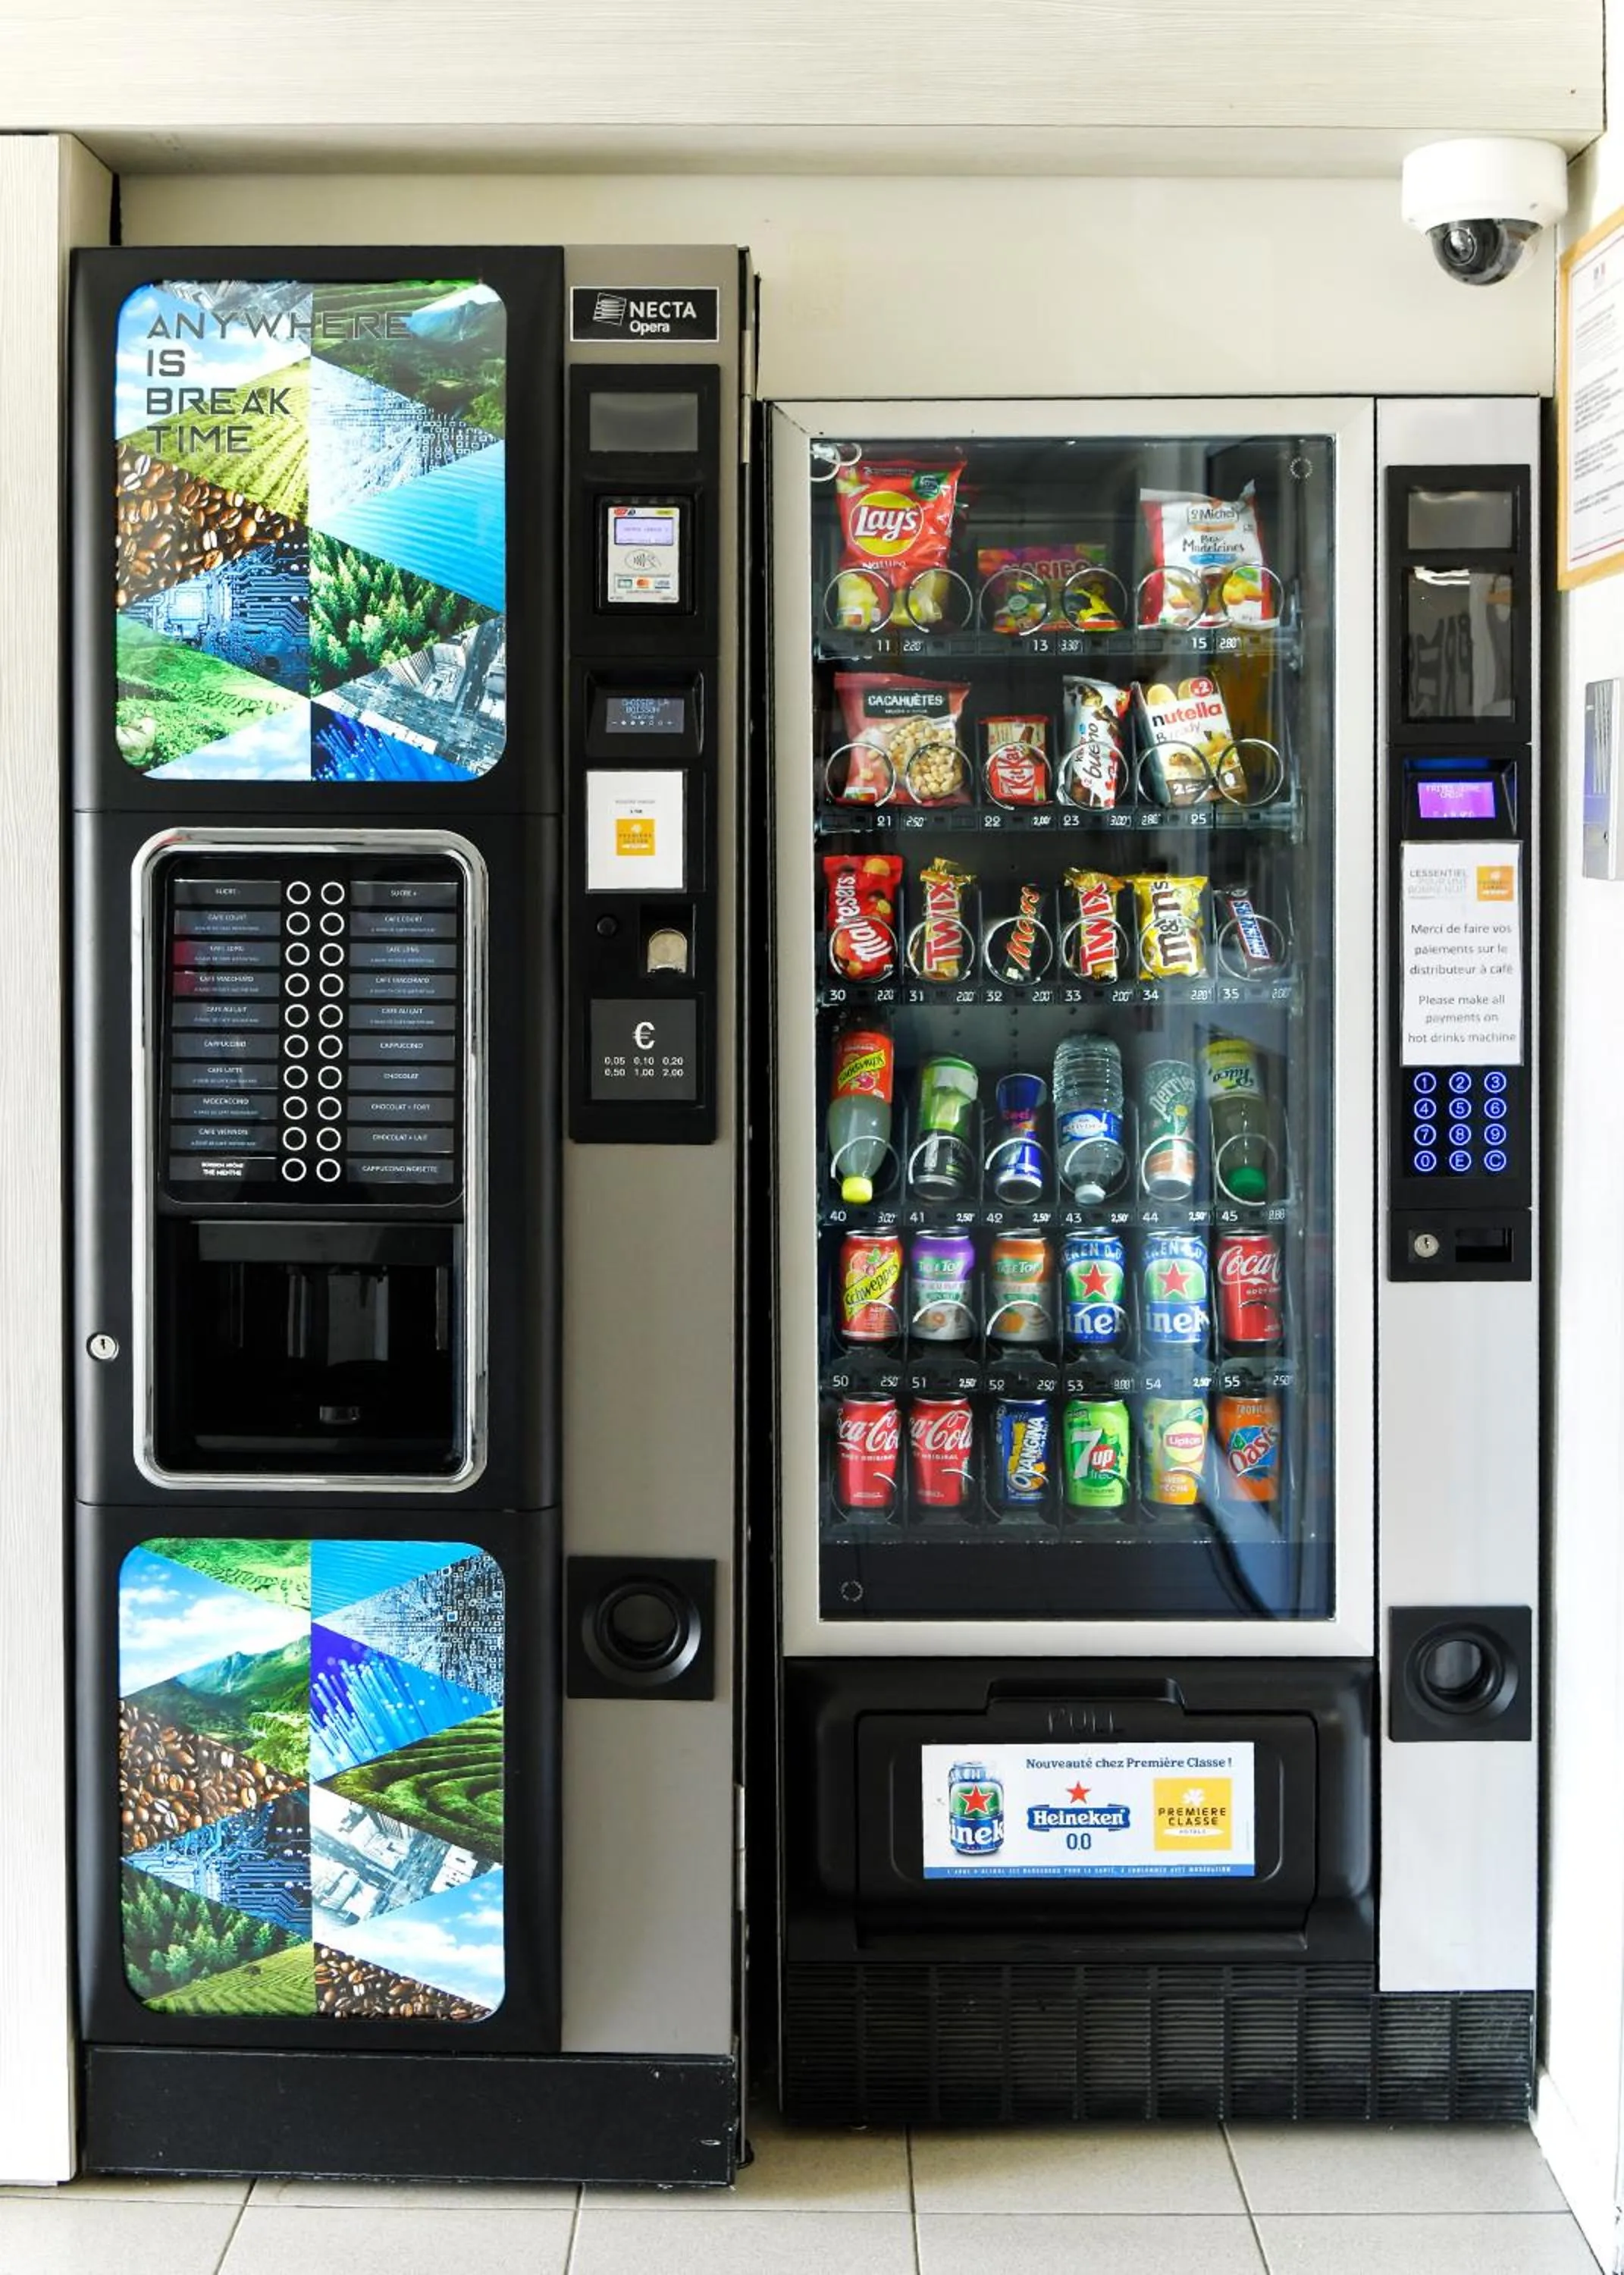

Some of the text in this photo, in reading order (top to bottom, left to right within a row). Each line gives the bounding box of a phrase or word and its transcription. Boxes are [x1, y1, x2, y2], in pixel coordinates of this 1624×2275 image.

[629, 301, 697, 318] NECTA
[146, 310, 414, 340] ANYWHERE
[629, 320, 670, 335] Opera
[146, 350, 186, 378] IS
[146, 388, 291, 416] BREAK
[147, 425, 254, 454] TIME
[854, 507, 919, 541] Lay's
[876, 640, 890, 652] 11
[1033, 639, 1049, 651] 13
[1193, 637, 1208, 649] 15
[867, 693, 944, 707] CACAHUÈTES
[1152, 701, 1224, 727] nutella
[1083, 723, 1102, 780] bueno
[923, 882, 963, 971] TWIX
[1080, 882, 1118, 976] TWIX
[1411, 923, 1513, 934] Merci de faire vos
[1414, 945, 1475, 956] paiements
[1497, 943, 1508, 954] le
[1409, 963, 1513, 975] distributeur à café
[829, 990, 846, 1001] 30
[910, 990, 923, 1001] 31
[986, 990, 1002, 1002] 32
[1065, 990, 1081, 1001] 33
[1143, 990, 1159, 1000] 34
[1223, 988, 1240, 999] 35
[1419, 994, 1505, 1006] Please make all
[1425, 1013, 1499, 1024] payments on
[632, 1021, 656, 1050] €
[1408, 1032, 1516, 1043] hot drinks machine
[1422, 1076, 1428, 1090] 1
[1455, 1076, 1466, 1089] 2
[1491, 1076, 1500, 1088] 3
[1419, 1102, 1429, 1115] 4
[1455, 1102, 1466, 1115] 5
[1490, 1102, 1500, 1114] 6
[1420, 1128, 1429, 1141] 7
[1455, 1128, 1466, 1141] 8
[1490, 1128, 1500, 1141] 9
[1420, 1155, 1430, 1167] 0
[1455, 1154, 1465, 1167] E
[1489, 1154, 1501, 1167] C
[829, 1211, 847, 1222] 40
[910, 1213, 925, 1222] 41
[986, 1213, 1003, 1222] 42
[1065, 1213, 1082, 1223] 43
[1143, 1212, 1158, 1222] 44
[1221, 1212, 1238, 1222] 45
[833, 1376, 849, 1387] 50
[912, 1376, 926, 1389] 51
[1068, 1379, 1083, 1392] 53
[1146, 1379, 1162, 1389] 54
[1224, 1376, 1240, 1387] 55
[1026, 1757, 1093, 1769] Nouveauté
[1096, 1758, 1124, 1768] chez
[1126, 1756, 1184, 1768] Première
[1187, 1757, 1225, 1768] Classe
[1033, 1809, 1125, 1825] Heineken
[1158, 1807, 1227, 1816] PREMIERE
[1168, 1816, 1219, 1825] CLASSE
